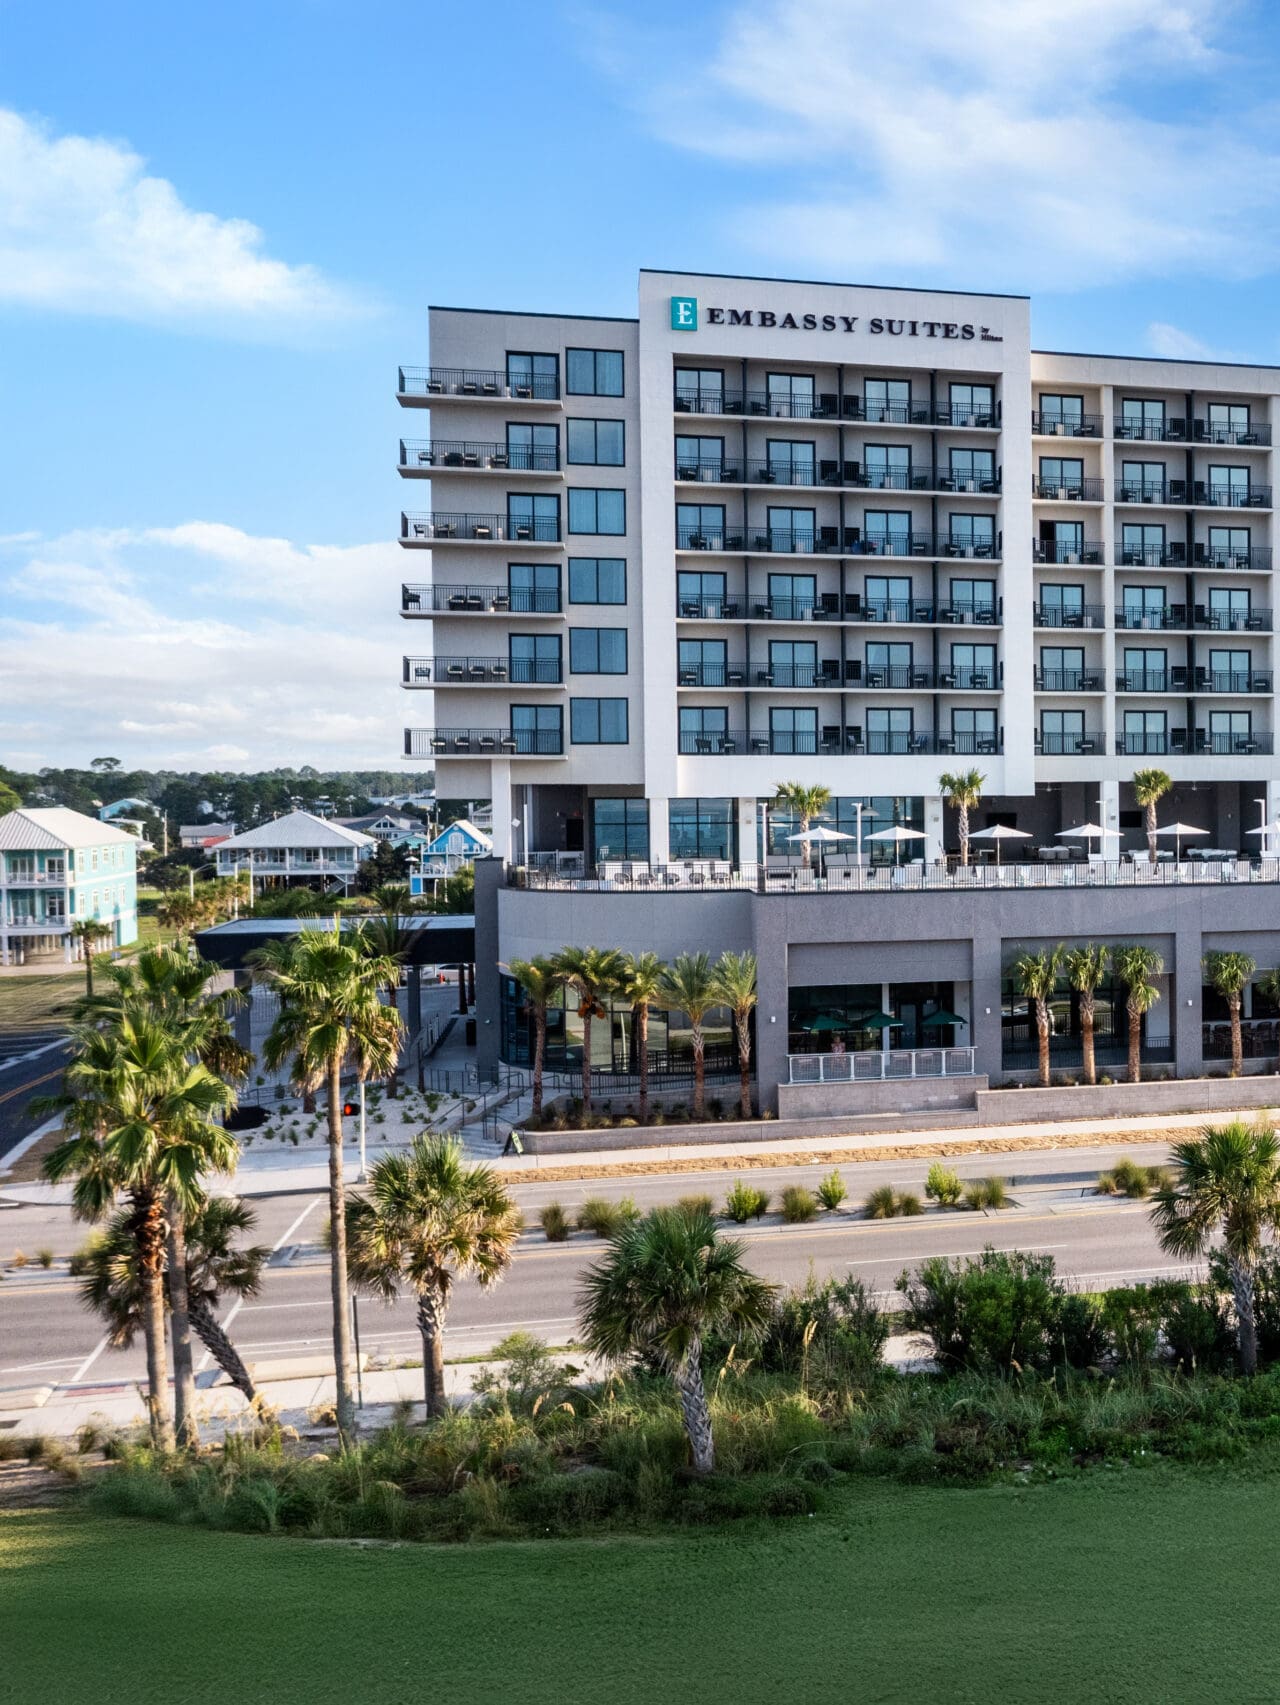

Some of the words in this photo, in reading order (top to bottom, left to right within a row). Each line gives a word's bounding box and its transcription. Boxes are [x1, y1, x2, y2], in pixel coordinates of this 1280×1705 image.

[677, 301, 693, 325] E
[706, 307, 859, 333] EMBASSY
[869, 317, 976, 341] SUITES
